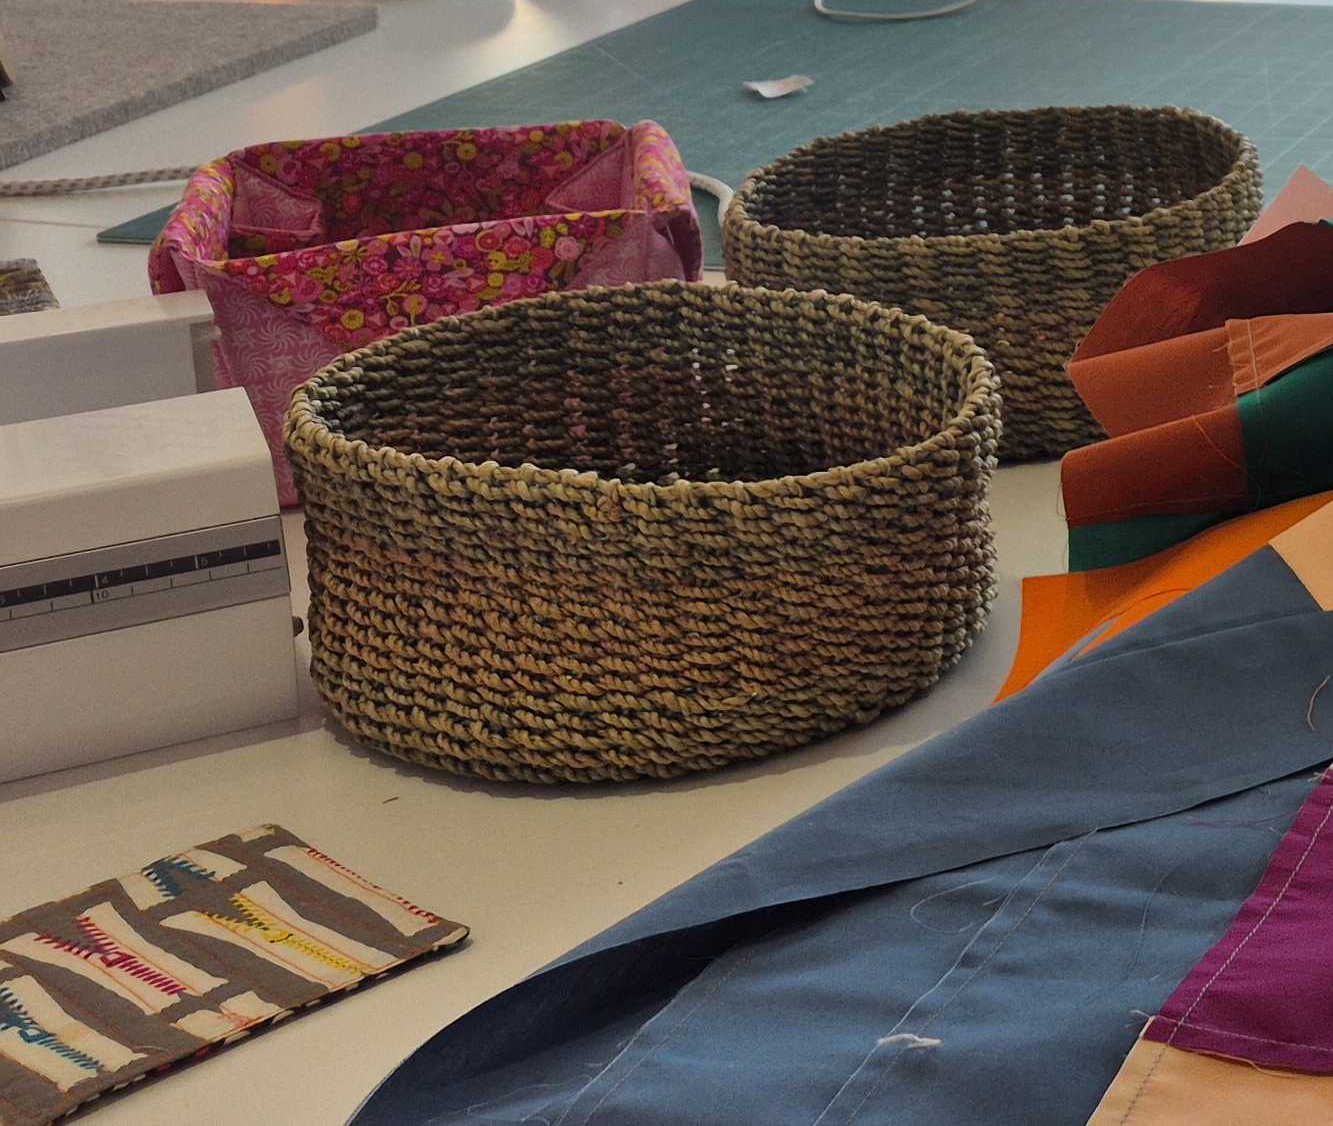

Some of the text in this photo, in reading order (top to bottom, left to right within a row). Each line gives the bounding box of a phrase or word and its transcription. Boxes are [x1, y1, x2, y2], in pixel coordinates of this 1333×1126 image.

[102, 575, 109, 585] 4
[201, 556, 209, 566] 5
[96, 589, 110, 601] 10
